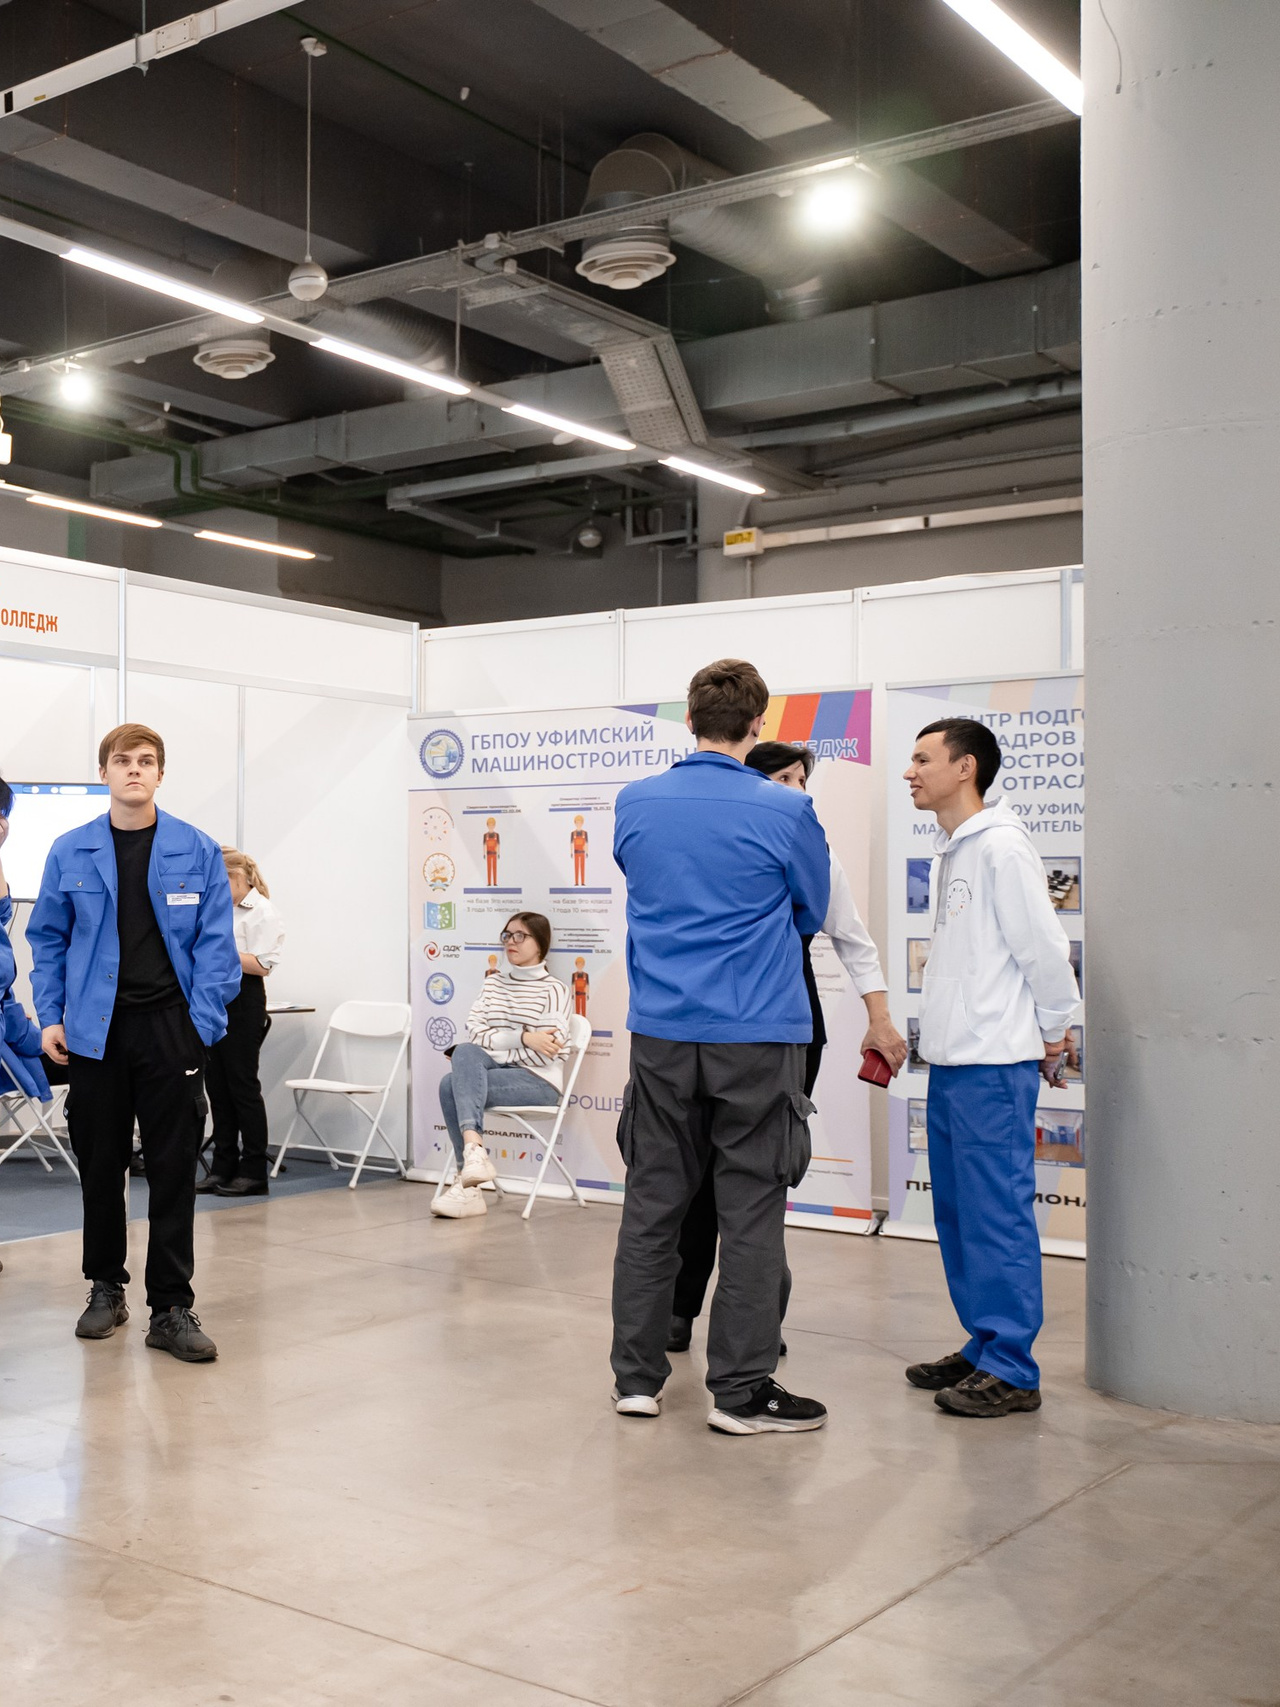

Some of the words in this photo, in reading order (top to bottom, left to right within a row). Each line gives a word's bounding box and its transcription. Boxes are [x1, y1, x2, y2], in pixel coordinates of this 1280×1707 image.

[1019, 708, 1084, 727] ПОДГ
[471, 731, 532, 751] ГБПОУ
[536, 720, 655, 748] УФИМСКИЙ
[997, 731, 1076, 750] АДРОВ
